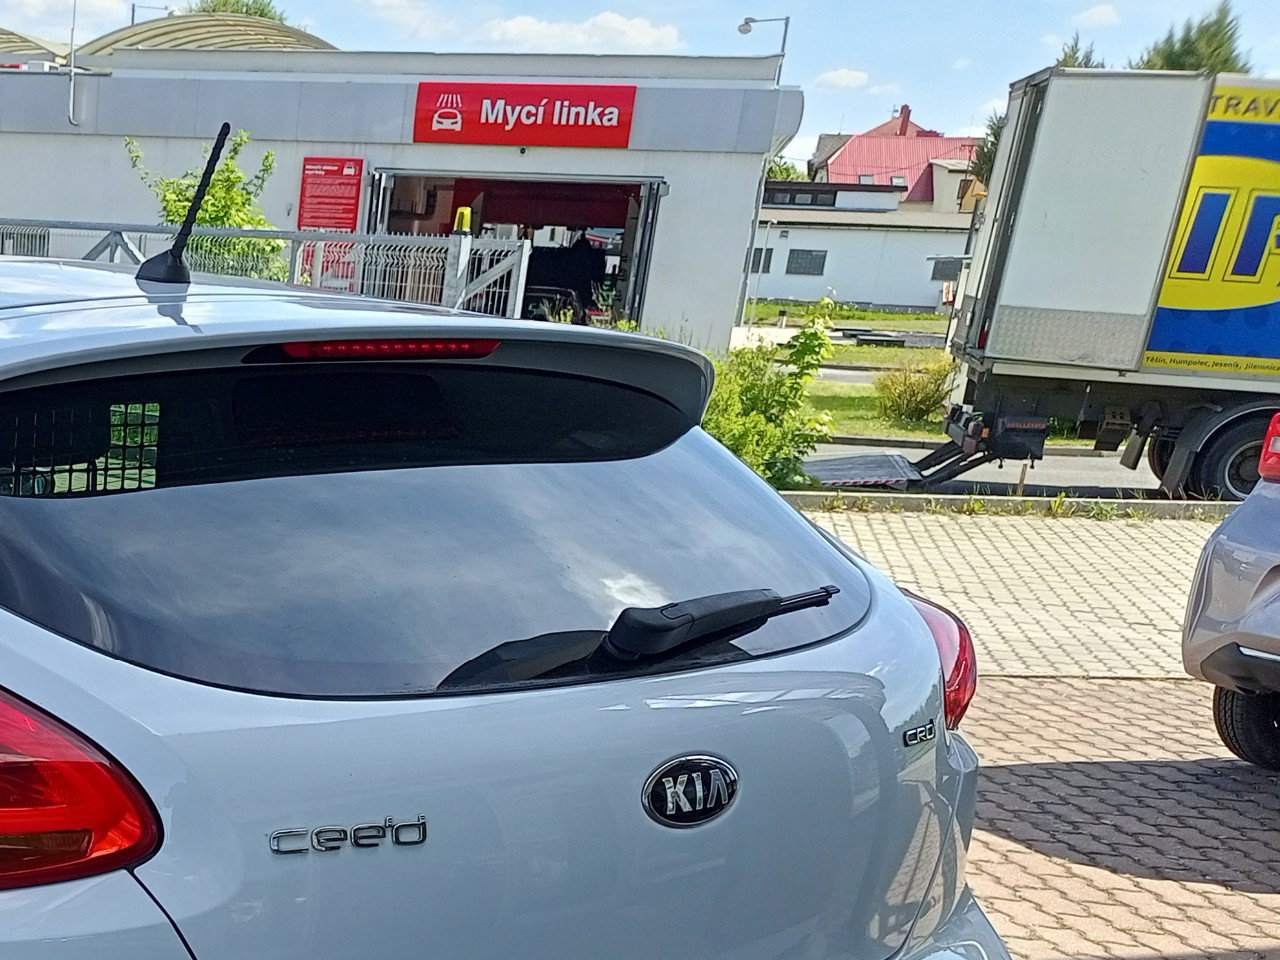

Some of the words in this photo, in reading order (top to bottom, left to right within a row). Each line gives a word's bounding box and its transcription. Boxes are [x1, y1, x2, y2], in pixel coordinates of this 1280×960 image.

[480, 99, 549, 131] Mycí
[553, 100, 619, 126] linka
[662, 769, 728, 815] KIA
